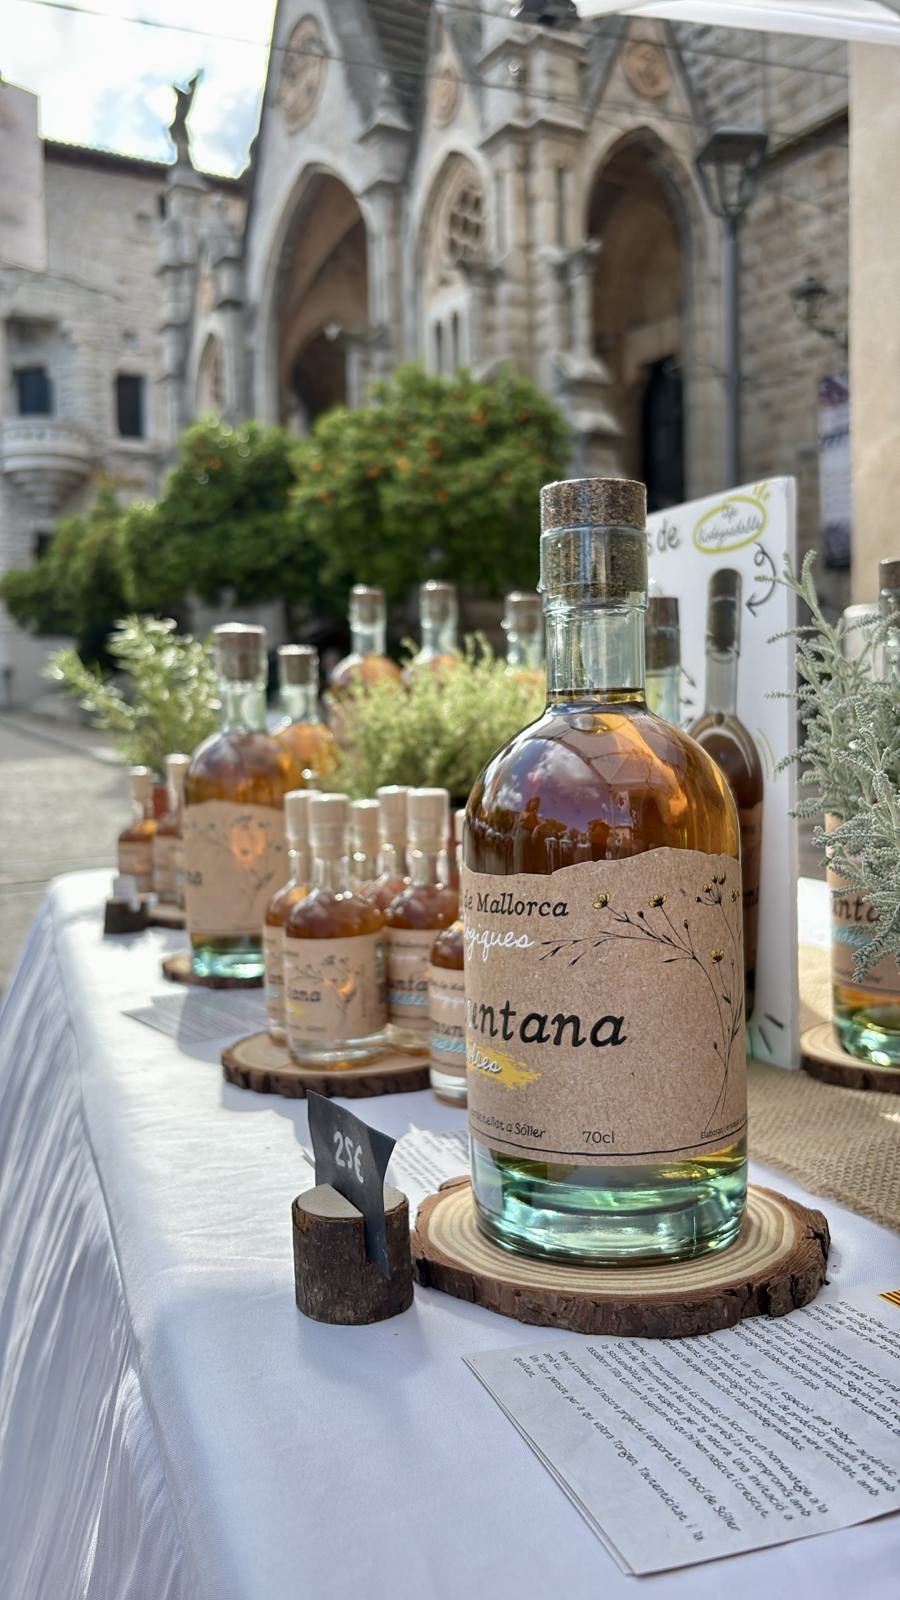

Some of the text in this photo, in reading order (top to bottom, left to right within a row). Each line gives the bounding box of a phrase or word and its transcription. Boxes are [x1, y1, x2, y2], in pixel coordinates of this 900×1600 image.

[656, 519, 680, 551] de
[477, 892, 569, 917] Mallorca
[333, 1130, 365, 1184] 25€
[514, 1122, 546, 1138] Sóller
[582, 1131, 615, 1144] 70cl
[537, 1363, 551, 1374] licor
[545, 1376, 568, 1394] pensat
[563, 1396, 580, 1404] per
[582, 1412, 598, 1420] qui
[594, 1422, 614, 1439] valora
[638, 1467, 687, 1521] l'autenticitat
[693, 1531, 704, 1542] la
[558, 1351, 572, 1361] Vine
[599, 1392, 621, 1409] nostre
[615, 1410, 646, 1432] projecte
[678, 1467, 692, 1477] un
[688, 1477, 711, 1494] bocí
[704, 1495, 717, 1505] de
[713, 1506, 740, 1531] Sóller
[586, 1347, 612, 1367] assaborir
[608, 1367, 622, 1377] l'illa
[619, 1378, 633, 1386] tal
[627, 1385, 642, 1396] com
[644, 1400, 668, 1418] sentim
[666, 1418, 678, 1426] els
[674, 1426, 691, 1434] qui
[692, 1440, 709, 1454] hem
[706, 1454, 734, 1479] nascut
[606, 1350, 644, 1382] sostenibilitat
[654, 1393, 685, 1416] respecte
[680, 1417, 698, 1426] per
[732, 1458, 750, 1473] Una
[748, 1474, 788, 1511] invitació
[614, 1342, 632, 1355] Serra
[675, 1394, 688, 1402] les
[684, 1402, 713, 1423] nostres
[710, 1423, 734, 1440] arrels
[739, 1447, 752, 1455] un
[749, 1456, 794, 1497] compromís
[790, 1499, 812, 1516] amb
[630, 1341, 650, 1356] Herbes
[648, 1356, 683, 1384] Tramuntana
[697, 1398, 721, 1414] només
[754, 1442, 767, 1451] un
[765, 1450, 812, 1497] homenatge
[816, 1504, 828, 1513] la
[751, 1369, 768, 1380] licor
[812, 1416, 832, 1425] amb
[830, 1427, 857, 1445] Sabor
